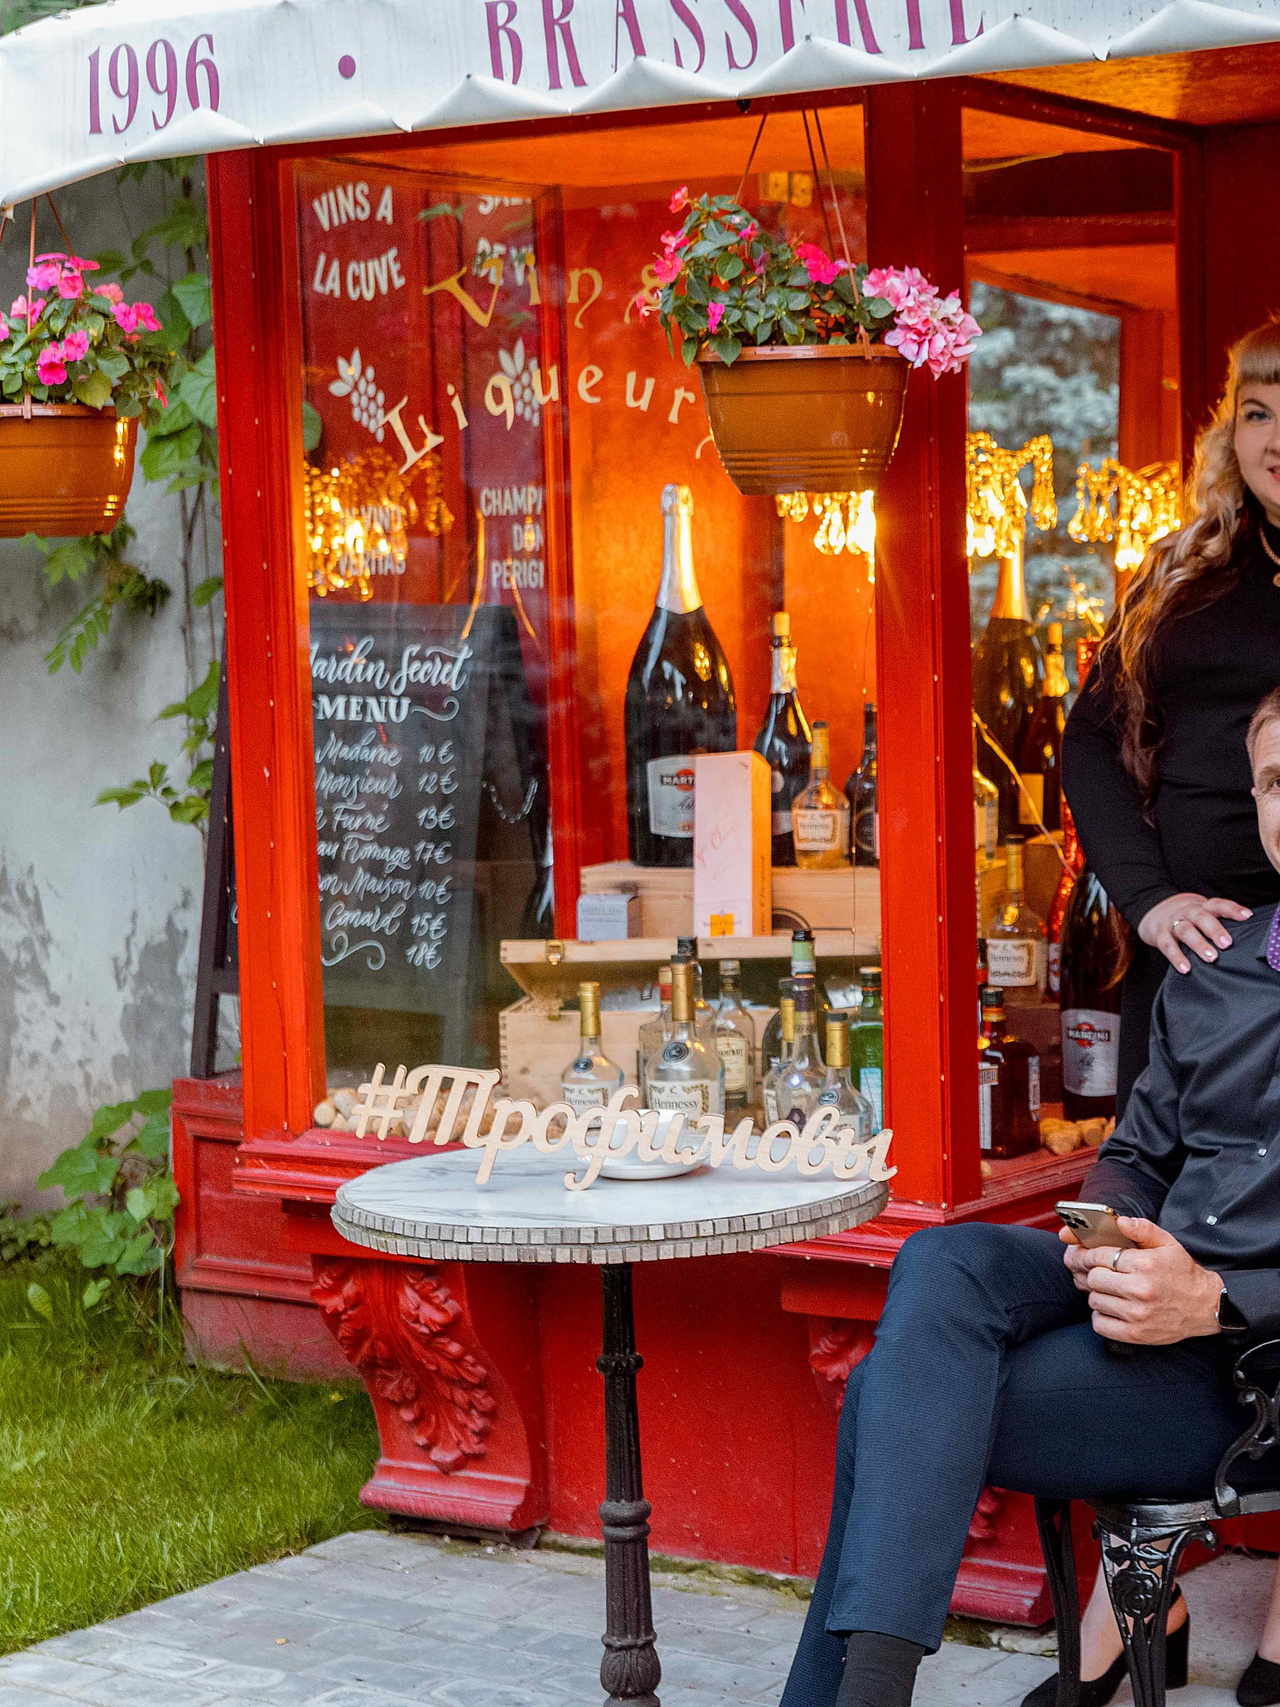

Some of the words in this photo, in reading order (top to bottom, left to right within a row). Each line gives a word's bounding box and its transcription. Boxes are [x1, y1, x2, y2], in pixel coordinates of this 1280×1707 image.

[88, 34, 220, 135] 1996
[313, 181, 371, 231] VINS
[376, 185, 393, 225] A
[313, 252, 340, 298] LA
[346, 247, 405, 301] CUVE
[375, 364, 715, 475] Liqueur
[390, 643, 473, 696] Secret
[316, 694, 411, 723] MENU
[315, 728, 401, 767] Madame
[315, 767, 403, 802] Monsieur
[661, 775, 695, 786] MART
[353, 1062, 898, 1191] #Трофимовы
[653, 1098, 700, 1111] Hennessy
